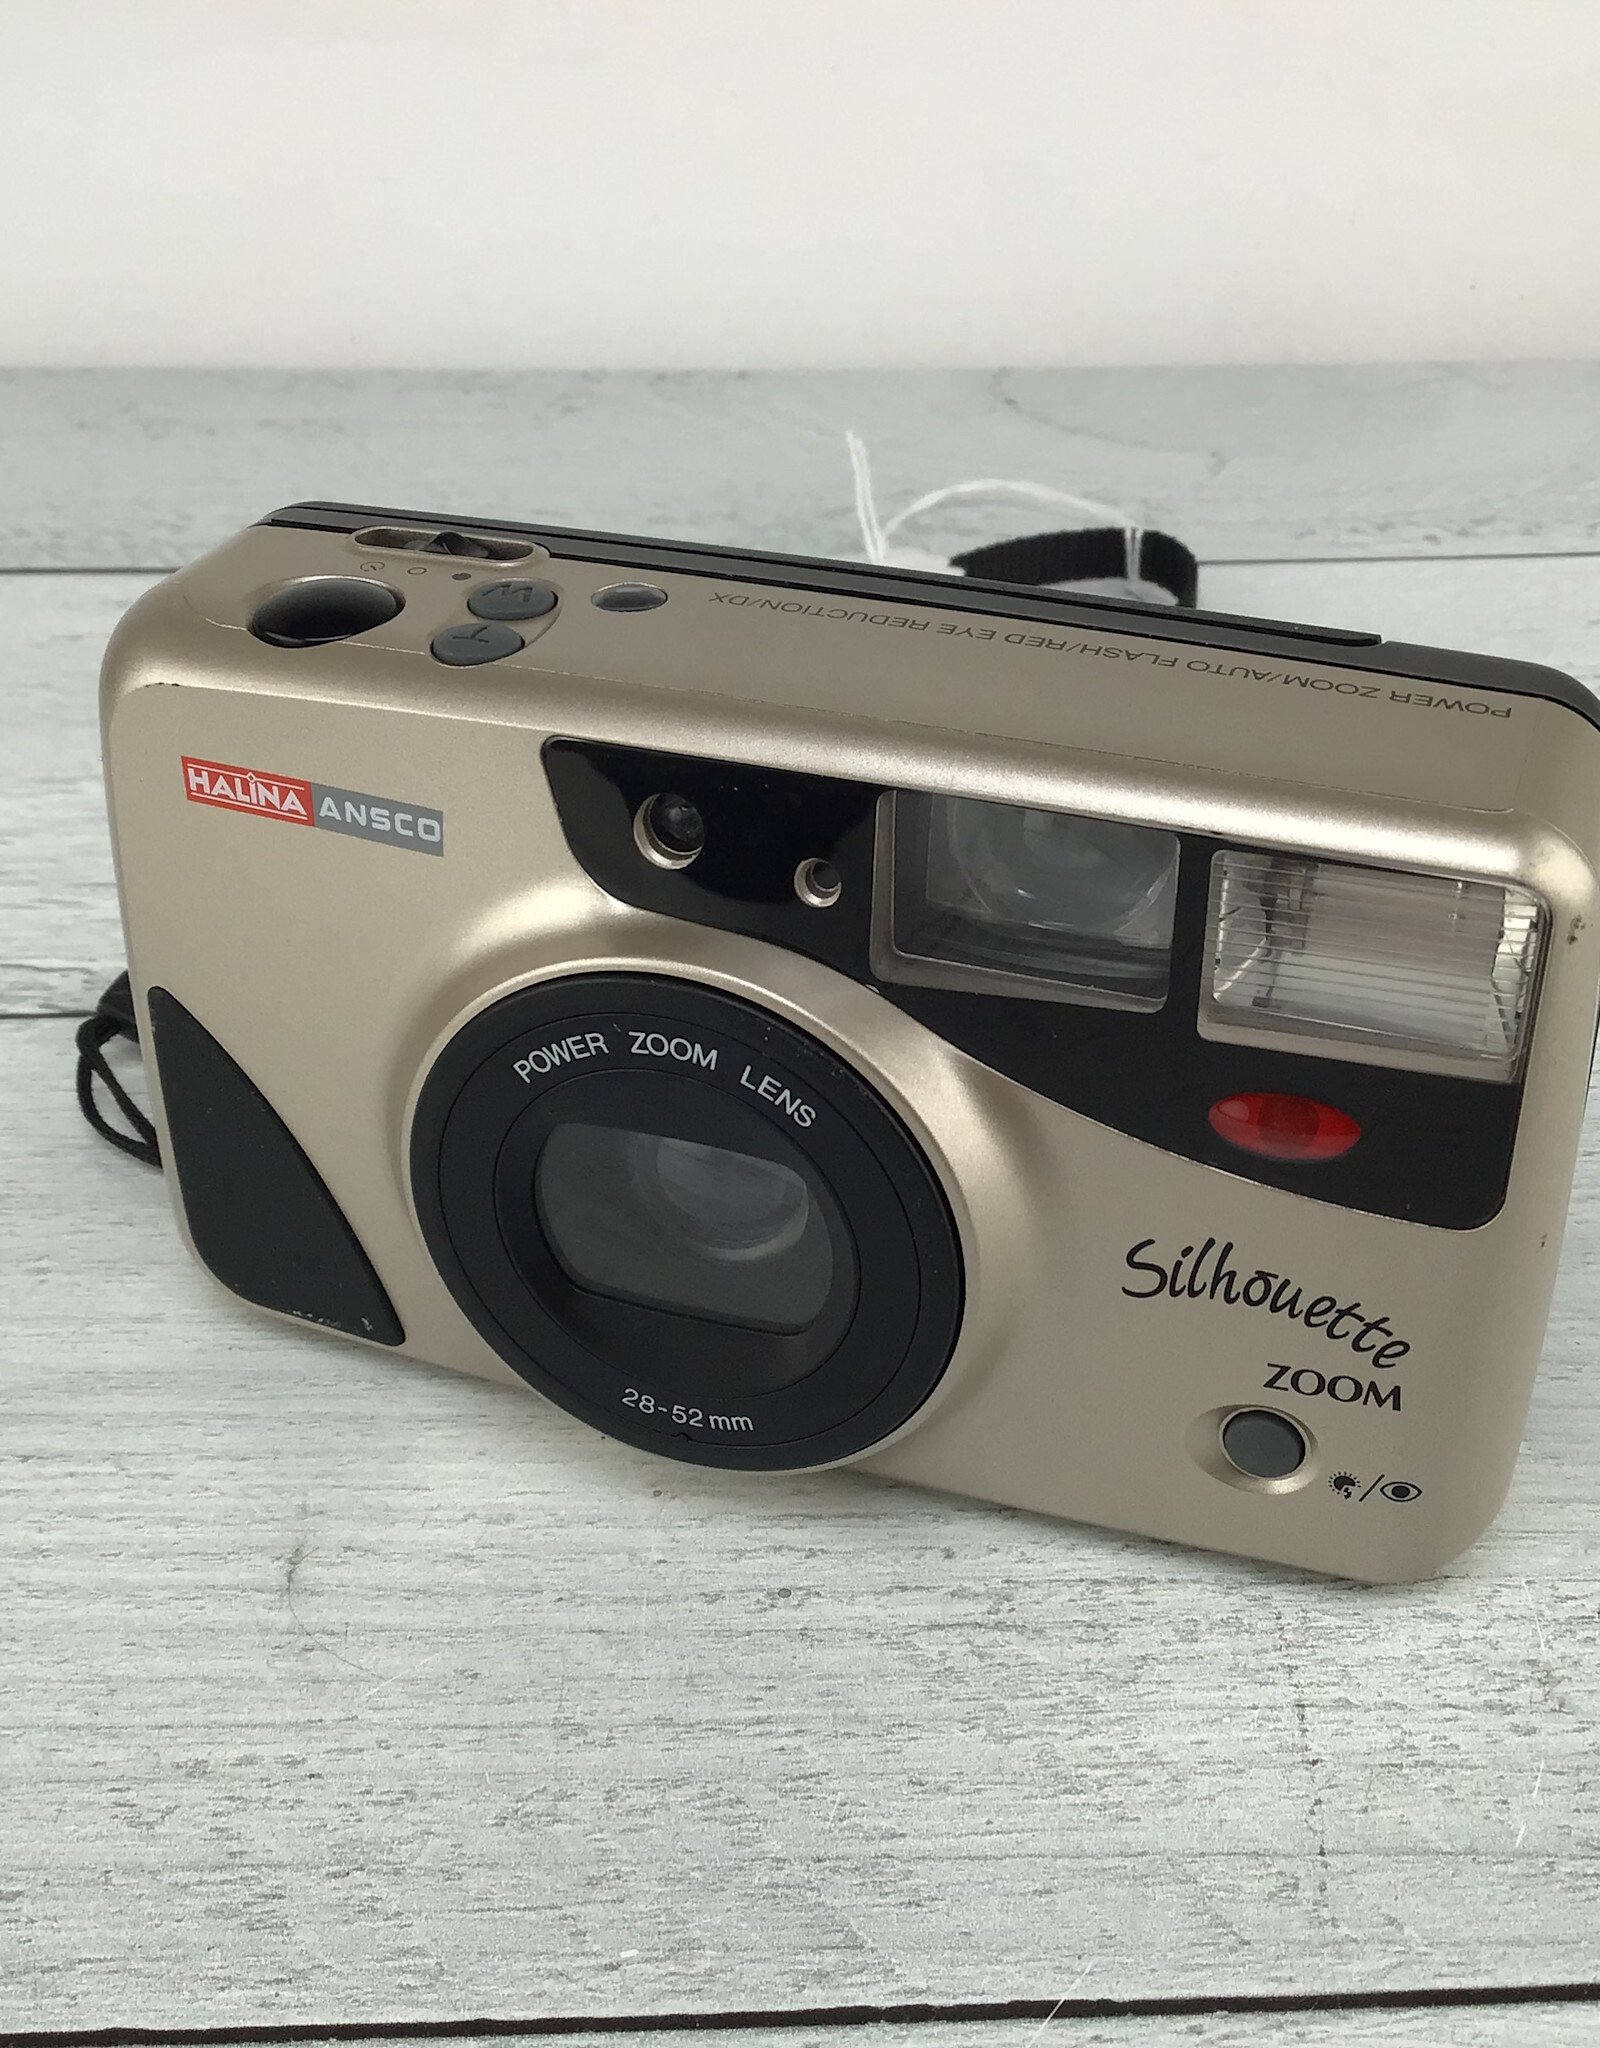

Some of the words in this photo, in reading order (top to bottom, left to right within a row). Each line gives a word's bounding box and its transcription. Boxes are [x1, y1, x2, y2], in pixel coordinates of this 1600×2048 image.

[709, 591, 931, 633] REDUCTION/DX
[936, 622, 998, 642] EYE
[1003, 632, 1179, 669] FLASH/RED
[1186, 659, 1381, 699] ZOOM/AUTO
[1390, 690, 1513, 719] POWER
[186, 766, 308, 816] HALINA
[318, 796, 442, 843] ANSCO
[512, 1032, 610, 1084] POWER
[628, 1031, 719, 1071] ZOOM
[739, 1064, 817, 1128] LENS
[1263, 1362, 1402, 1412] ZOOM
[621, 1387, 704, 1428] 28-52
[708, 1414, 755, 1432] mm
